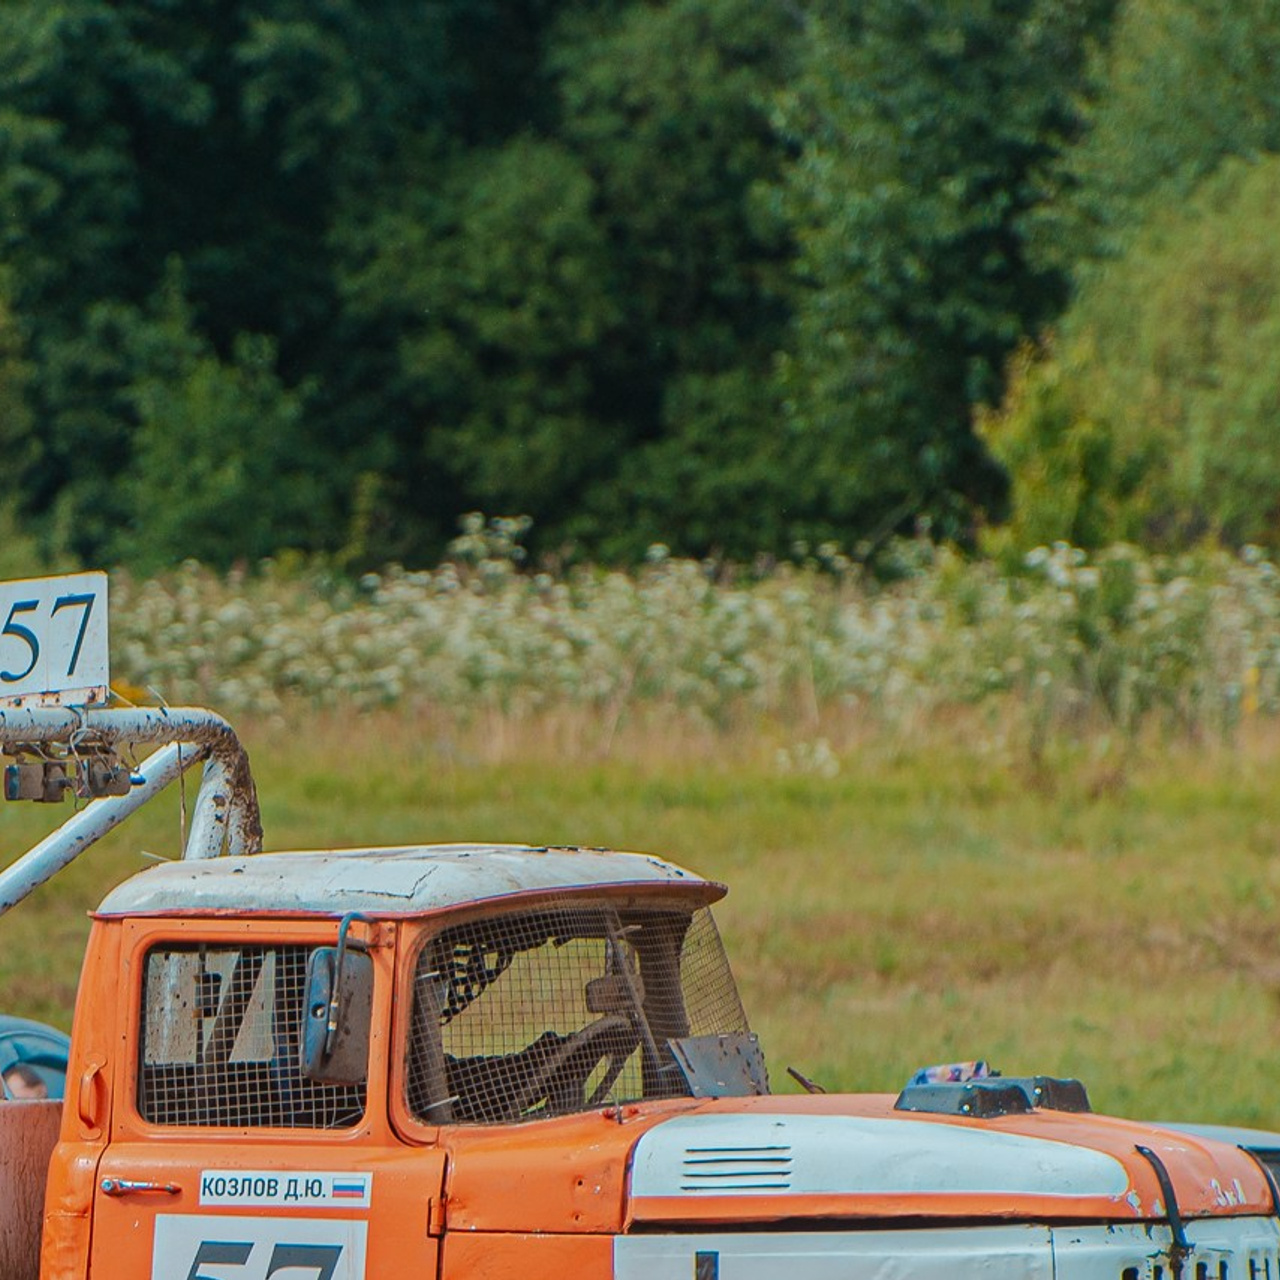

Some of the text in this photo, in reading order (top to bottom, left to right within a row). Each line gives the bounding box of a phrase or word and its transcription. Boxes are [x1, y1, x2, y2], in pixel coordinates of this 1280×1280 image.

[0, 593, 96, 682] 57
[202, 1177, 326, 1201] КОЗЛОВ Д.Ю.
